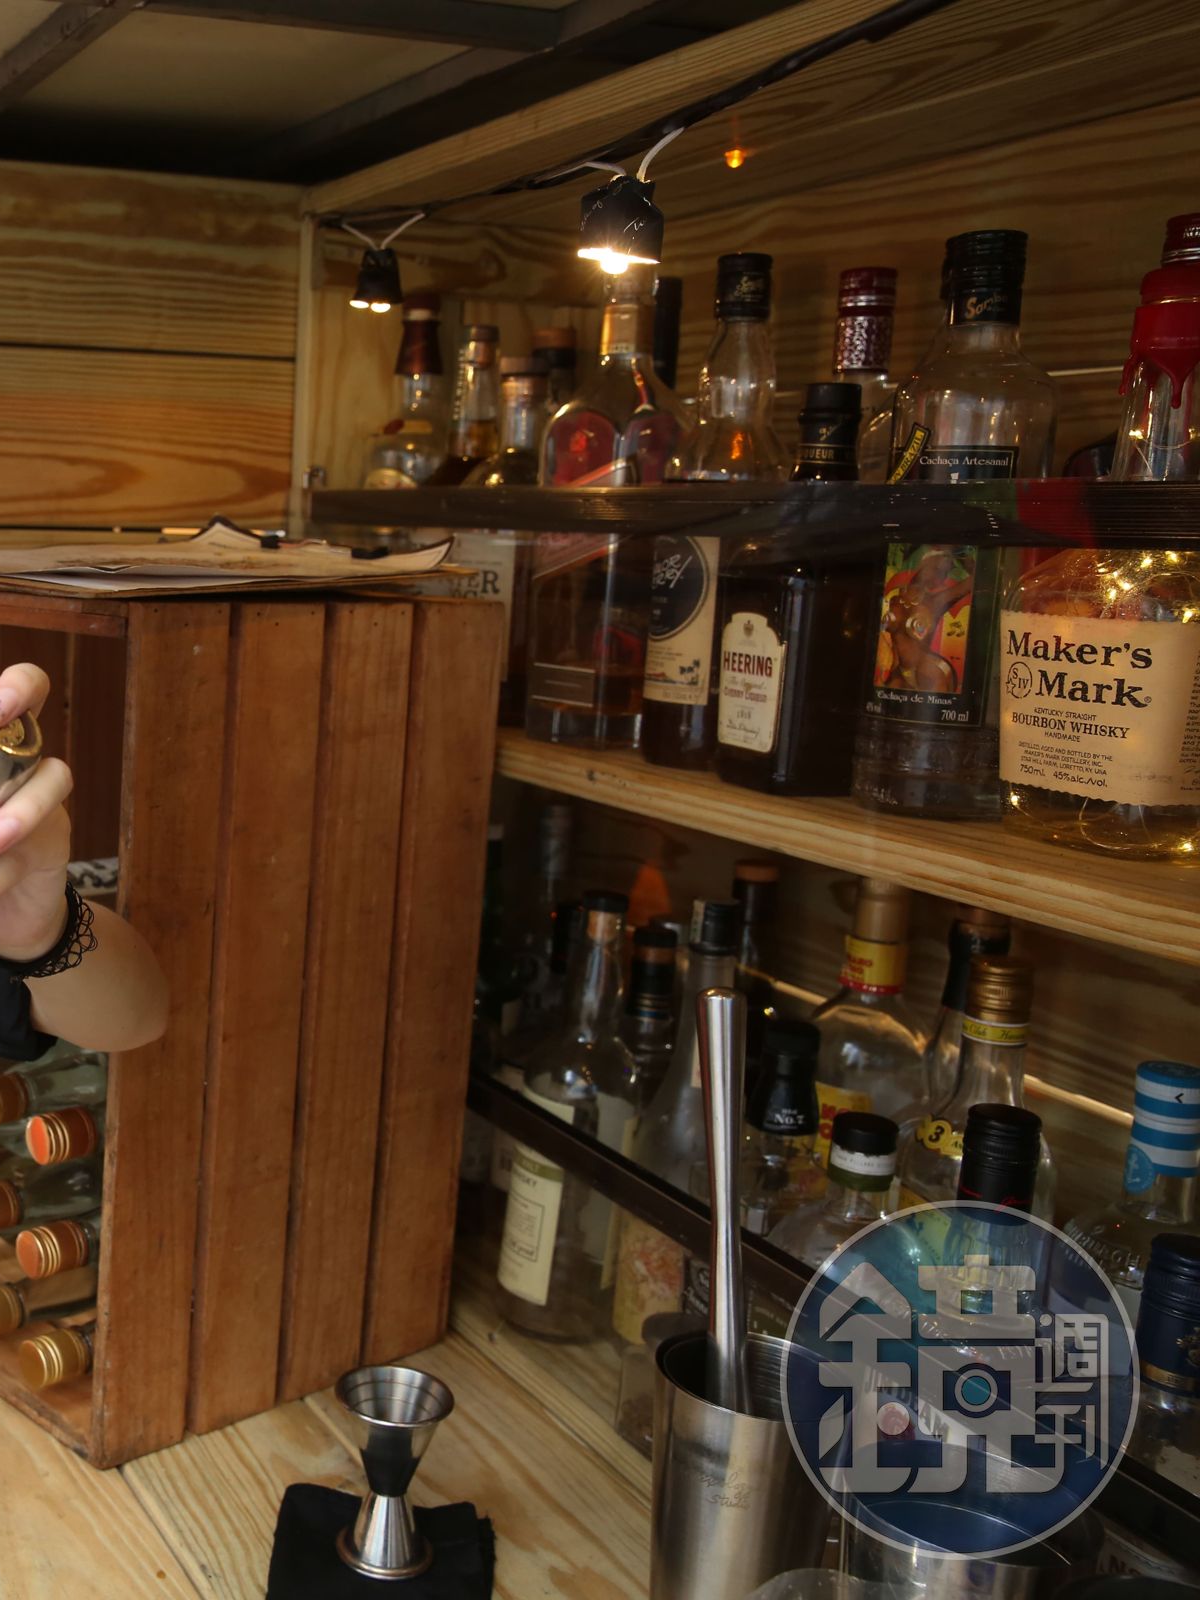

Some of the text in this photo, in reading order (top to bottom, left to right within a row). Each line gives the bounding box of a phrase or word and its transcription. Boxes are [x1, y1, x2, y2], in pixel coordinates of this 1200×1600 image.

[919, 455, 1009, 467] Cachaça Artesanal
[1006, 629, 1153, 669] Maker's
[722, 650, 773, 677] HEERING
[940, 709, 969, 722] 700 ml
[1034, 706, 1097, 722] KENTUCKY STRAIGHT
[1011, 711, 1130, 739] BOURBON WHISKY
[1044, 731, 1081, 743] HANDMADE
[1067, 749, 1092, 759] BOTTLED
[1092, 752, 1101, 760] BY
[1101, 754, 1113, 762] THE
[928, 1125, 945, 1144] 3
